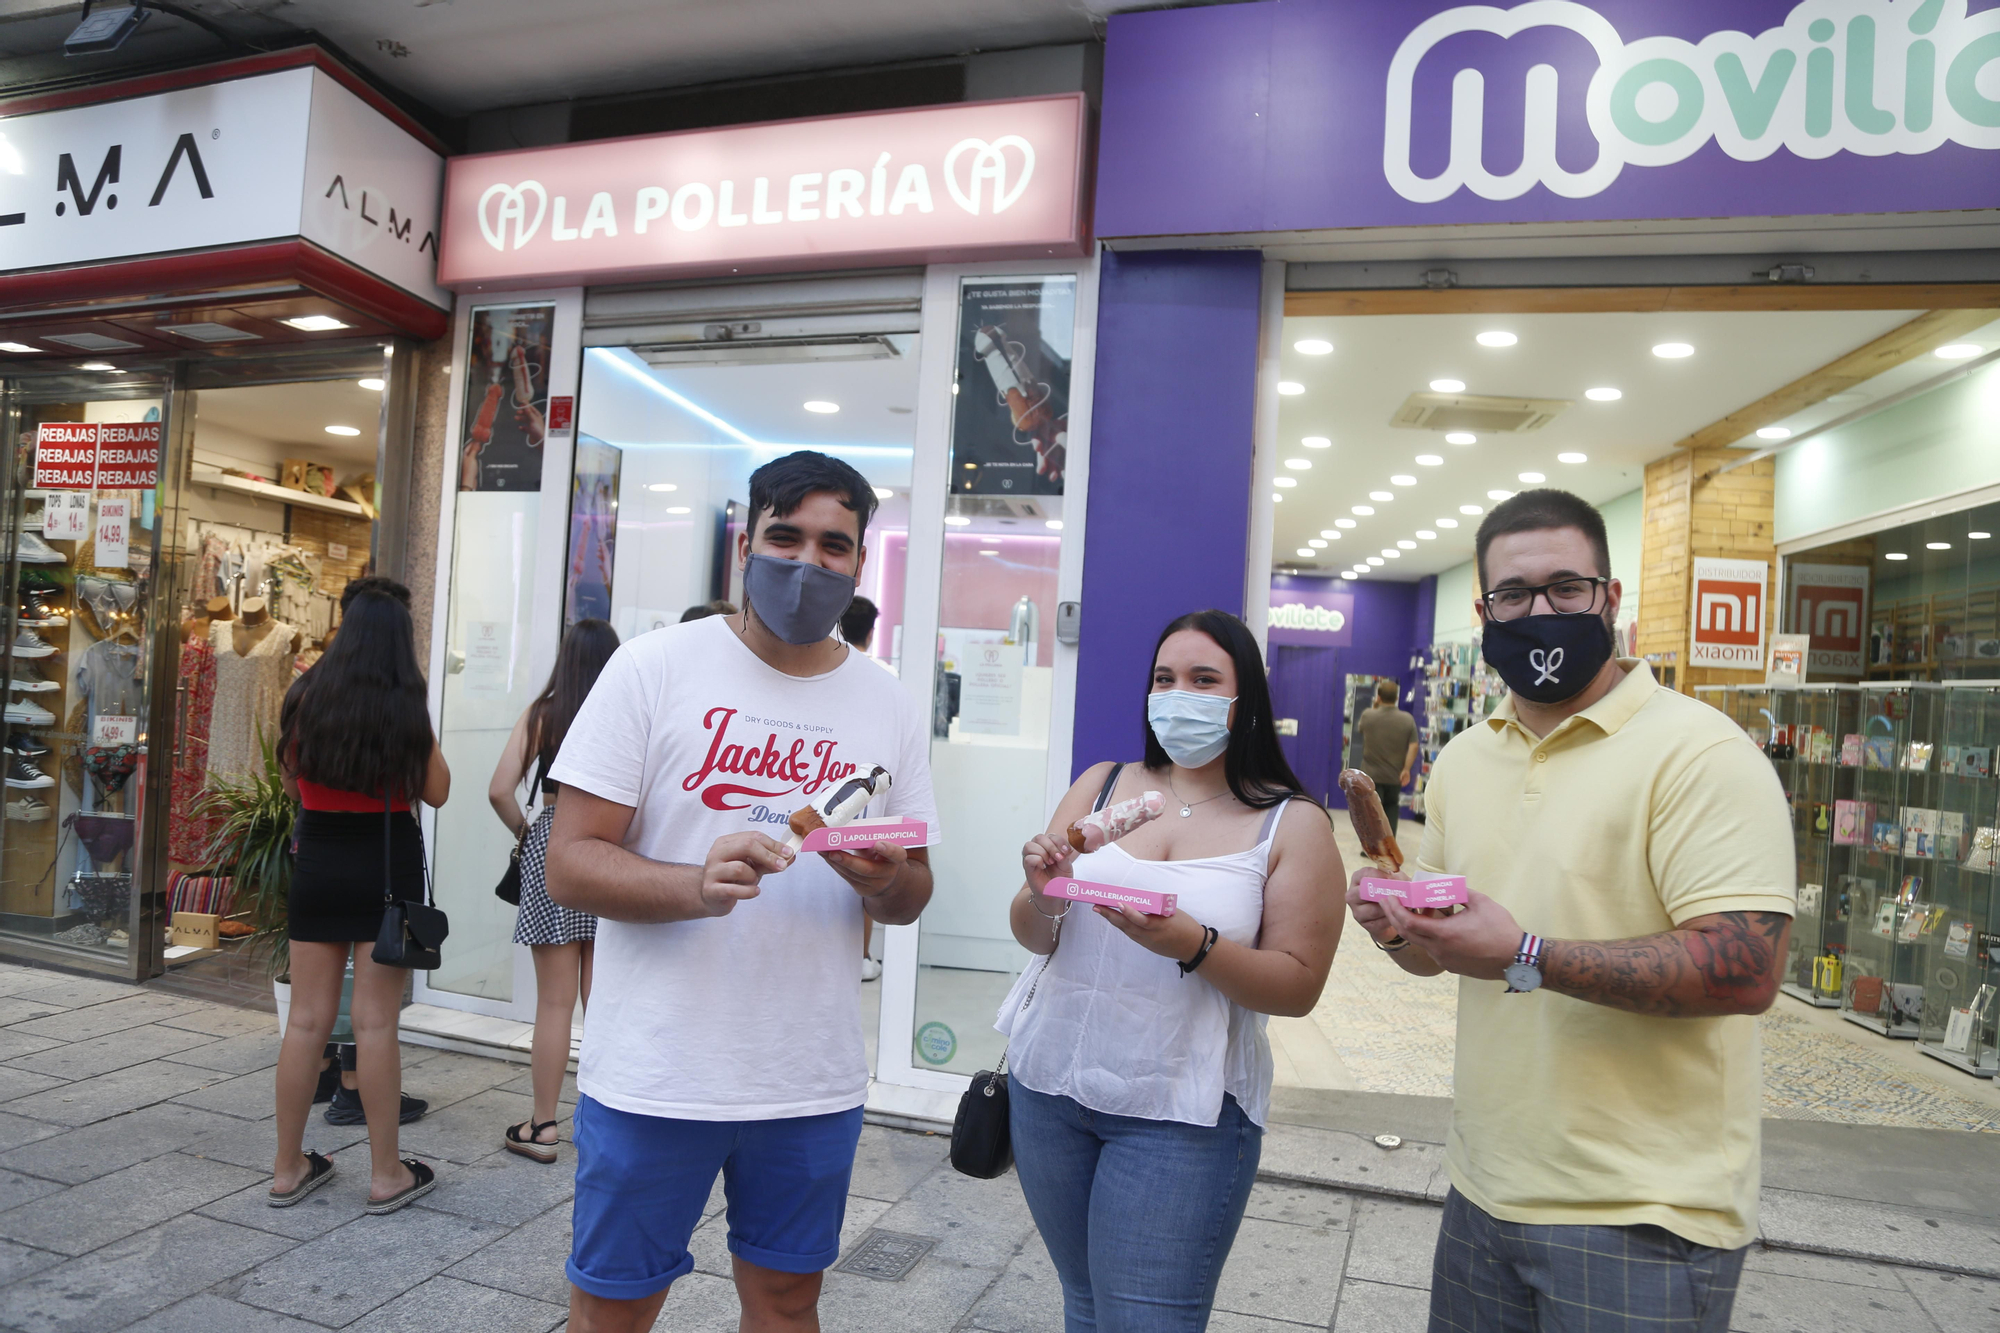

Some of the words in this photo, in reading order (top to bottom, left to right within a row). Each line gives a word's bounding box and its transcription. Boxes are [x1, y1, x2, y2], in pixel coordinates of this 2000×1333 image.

[551, 191, 618, 241] LA
[634, 151, 934, 235] POLLERÍA
[325, 174, 438, 262] ALMA
[40, 428, 96, 443] REBAJAS
[101, 427, 159, 443] REBAJAS
[39, 449, 94, 464] REBAJAS
[100, 449, 158, 464] REBAJAS
[37, 469, 93, 485] REBAJAS
[98, 470, 157, 485] REBAJAS
[48, 494, 61, 508] TOPS
[101, 505, 124, 517] BIKINIS
[1698, 567, 1762, 580] DISTRIBUIDOR
[1694, 645, 1759, 662] xiaomi
[745, 715, 761, 724] DRY
[763, 718, 794, 729] GOODS
[803, 724, 834, 734] SUPPLY
[748, 805, 792, 825] Deni
[843, 830, 919, 842] LAPOLLERIAOFICIAL
[1080, 888, 1152, 906] LAPOLLERIAOFICIAL
[174, 926, 211, 936] ALMA
